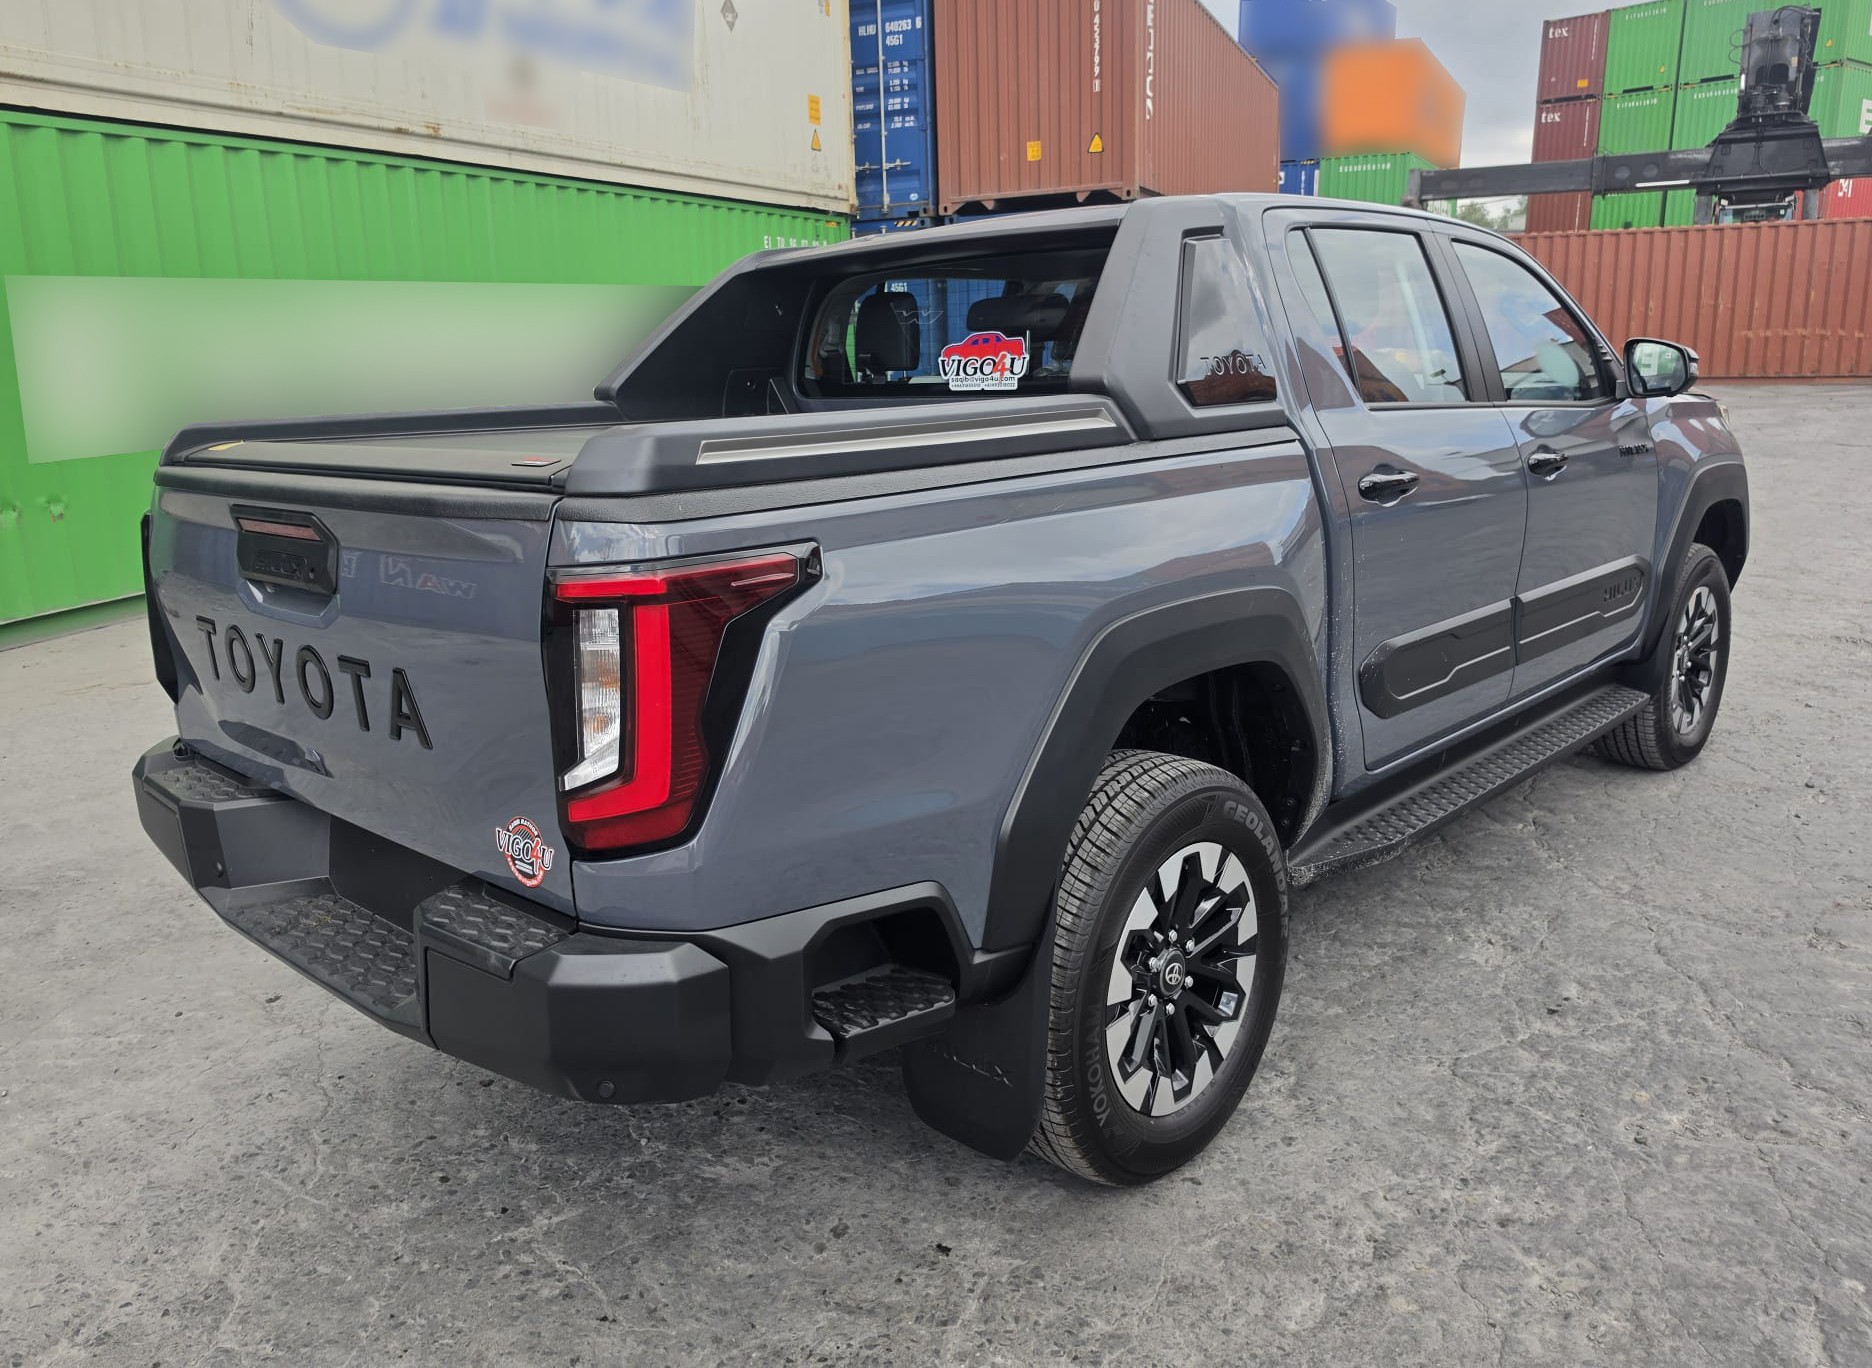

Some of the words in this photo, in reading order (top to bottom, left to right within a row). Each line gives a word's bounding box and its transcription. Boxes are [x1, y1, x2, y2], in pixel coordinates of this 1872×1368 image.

[940, 353, 1026, 379] VIGO4U
[1200, 353, 1266, 375] TOYOTA
[196, 615, 434, 750] TOYOTA
[496, 828, 554, 875] VIGO4U
